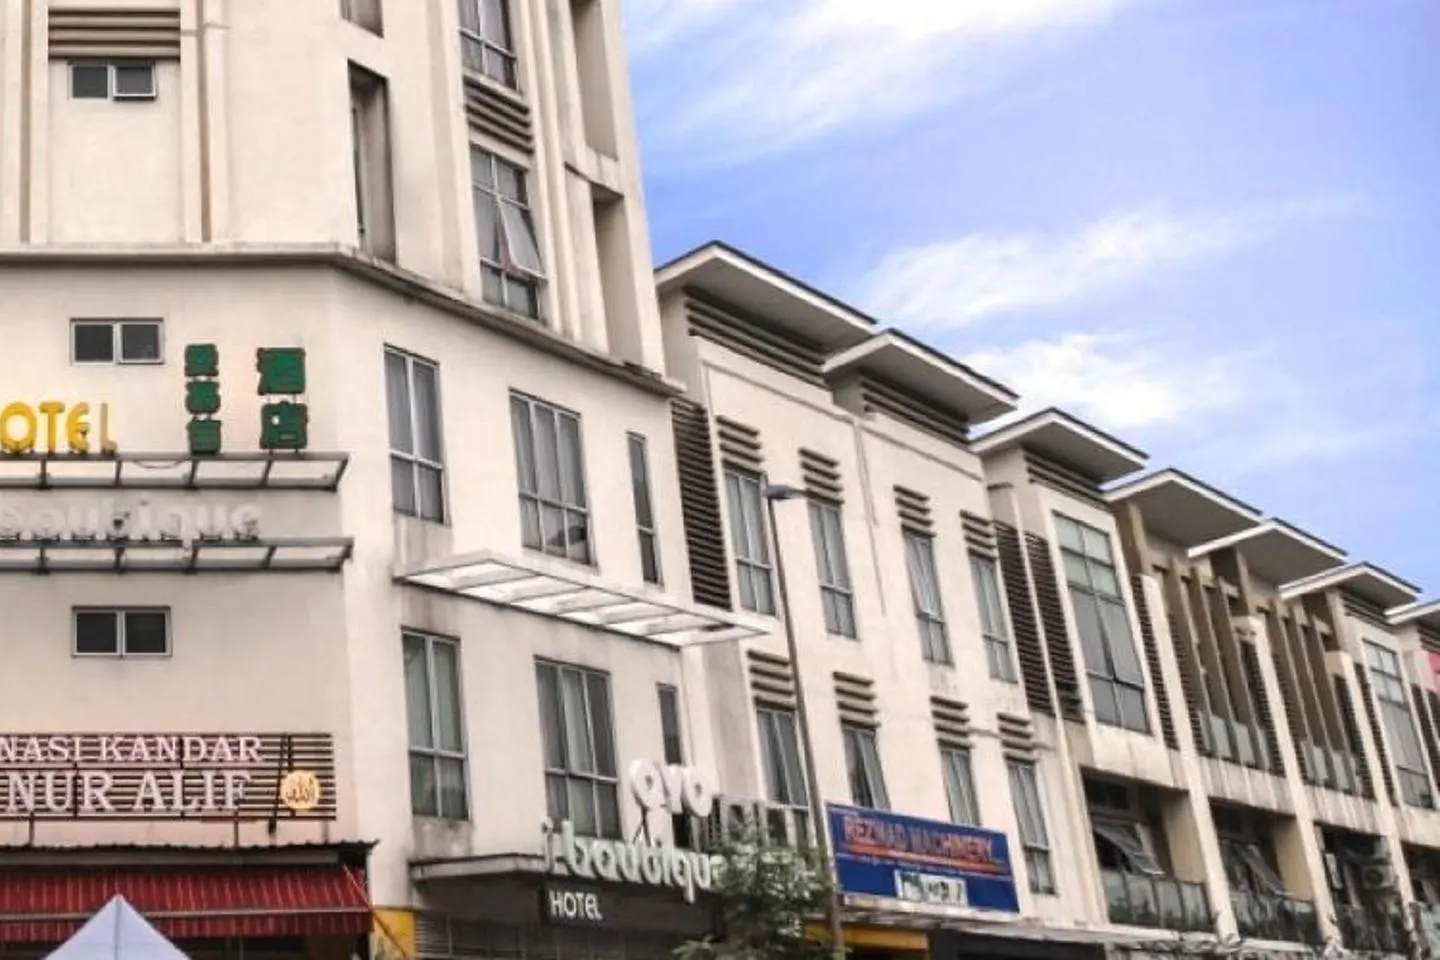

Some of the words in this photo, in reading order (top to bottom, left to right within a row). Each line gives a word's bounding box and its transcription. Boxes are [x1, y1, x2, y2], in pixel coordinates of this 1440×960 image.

[98, 736, 263, 762] KANDAR
[5, 769, 114, 813] NUR
[131, 769, 253, 812] ALIF
[548, 889, 603, 920] HOTEL
